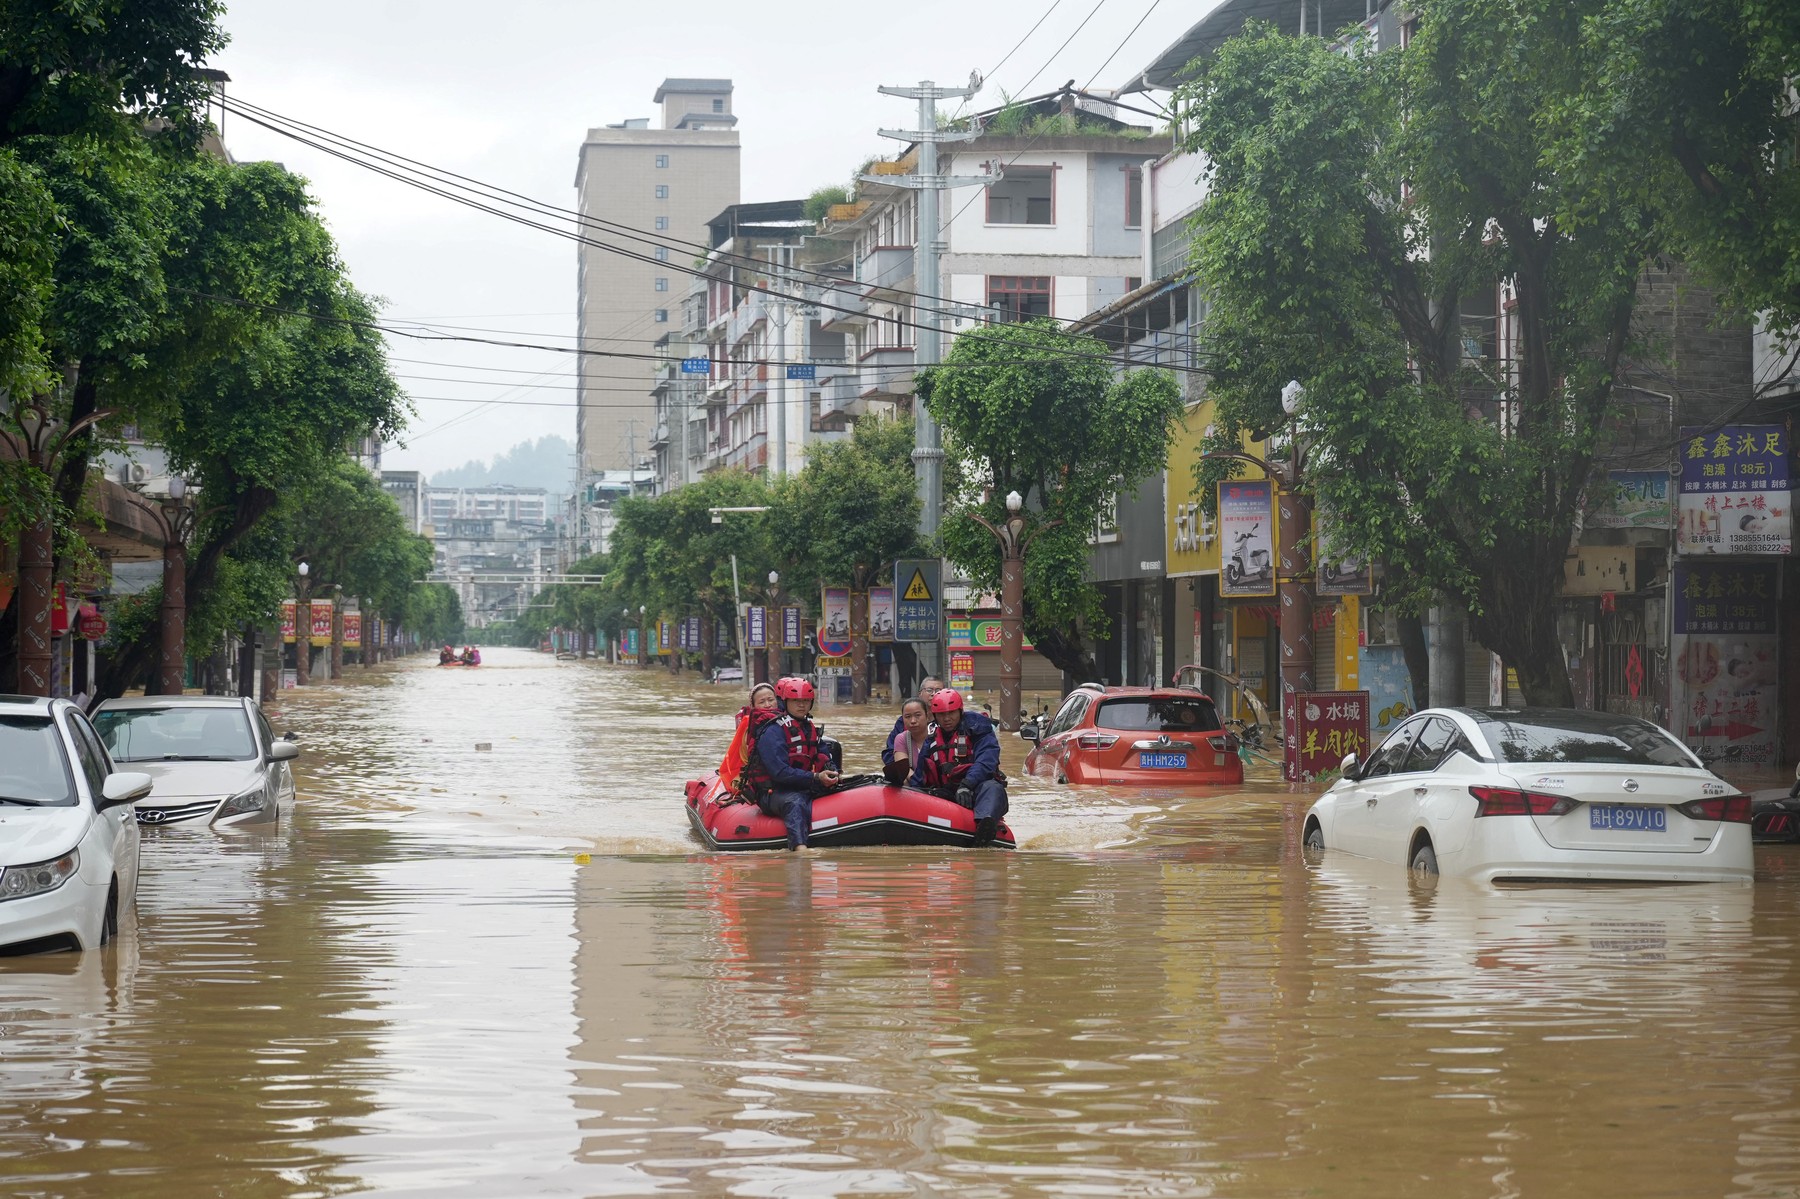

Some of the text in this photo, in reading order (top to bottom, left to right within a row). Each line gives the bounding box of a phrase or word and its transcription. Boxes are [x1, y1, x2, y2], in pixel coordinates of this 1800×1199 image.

[1686, 432, 1784, 459] 鑫鑫沐足
[1685, 481, 1700, 491] 按摩
[1704, 481, 1727, 491] 木桶沐
[1731, 480, 1747, 490] 足沐
[1704, 494, 1767, 512] 请上二楼
[1729, 534, 1781, 543] 13885551644
[1730, 544, 1781, 552] 19048336222
[898, 605, 936, 617] 学生出入
[898, 619, 936, 631] 车辆慢行
[985, 626, 1002, 643] 彭
[1325, 701, 1361, 721] 水城
[1302, 728, 1366, 760] 羊肉粉
